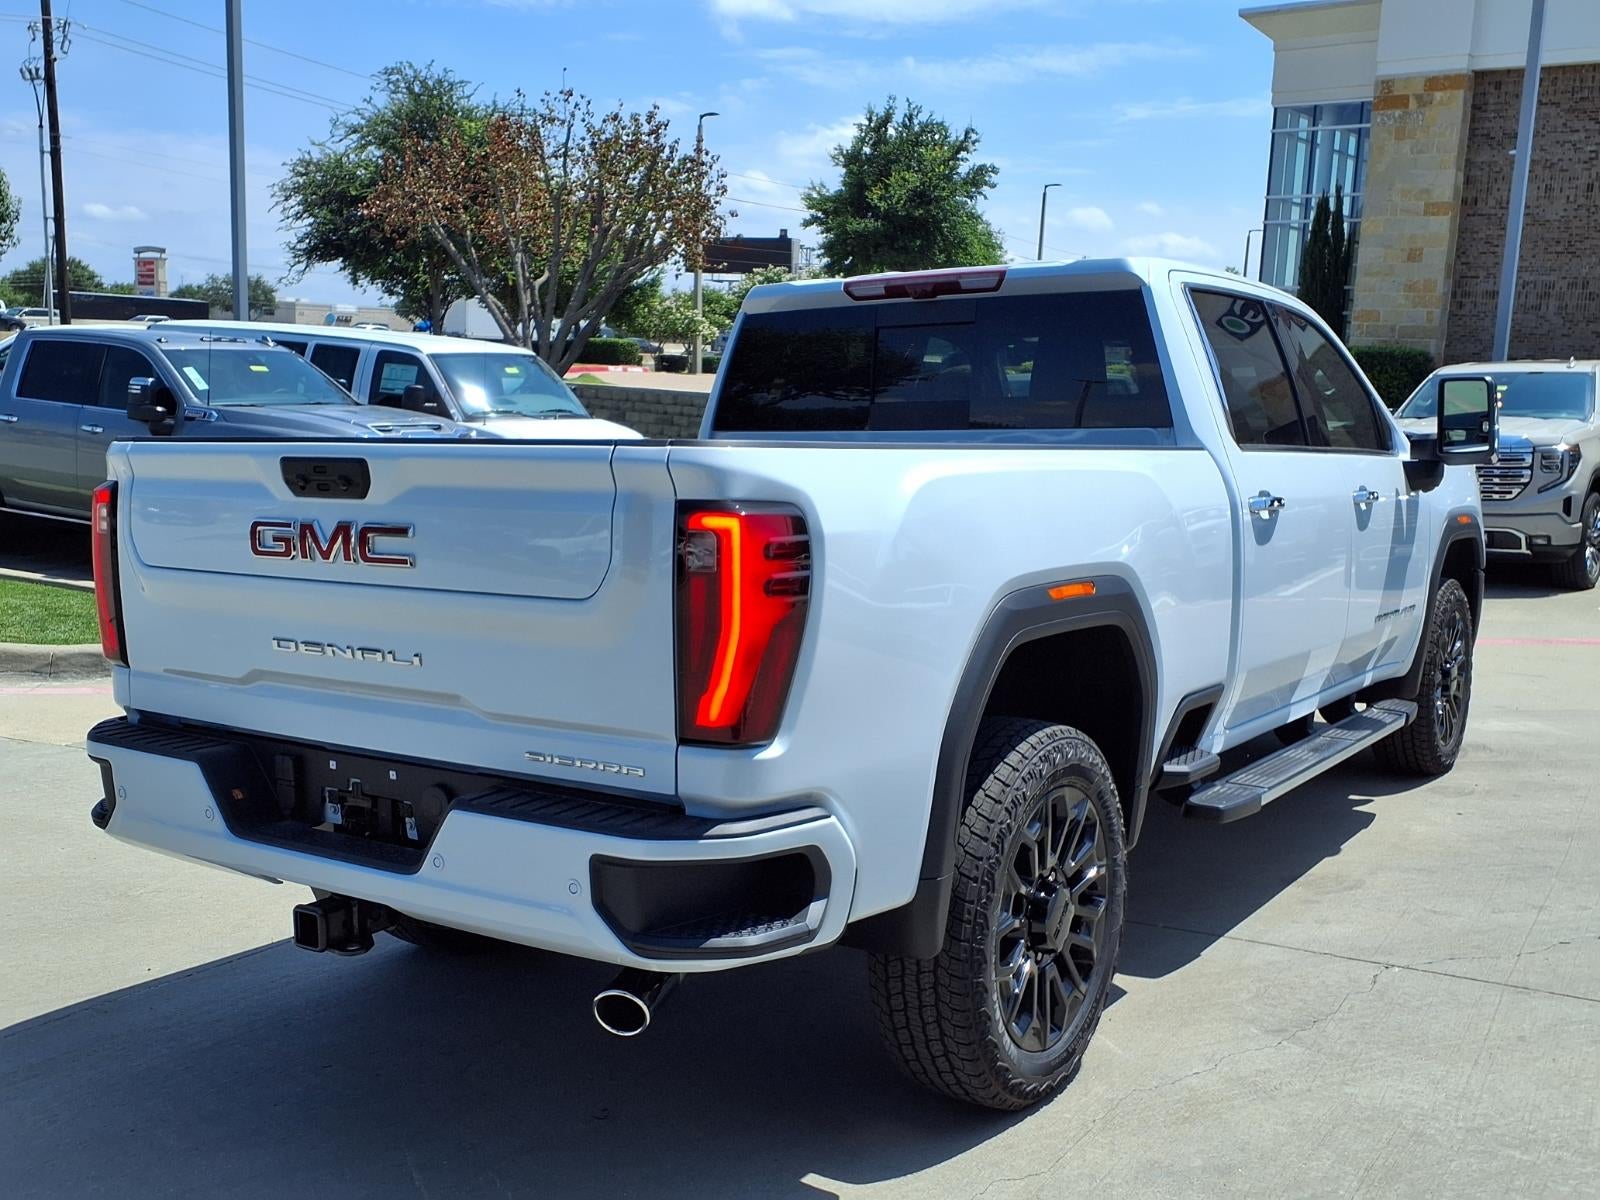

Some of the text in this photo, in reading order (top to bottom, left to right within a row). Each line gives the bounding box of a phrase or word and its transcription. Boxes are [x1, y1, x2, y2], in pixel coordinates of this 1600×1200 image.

[249, 517, 416, 568] GMC
[271, 636, 423, 667] DENALI
[524, 751, 646, 778] SIERRA
